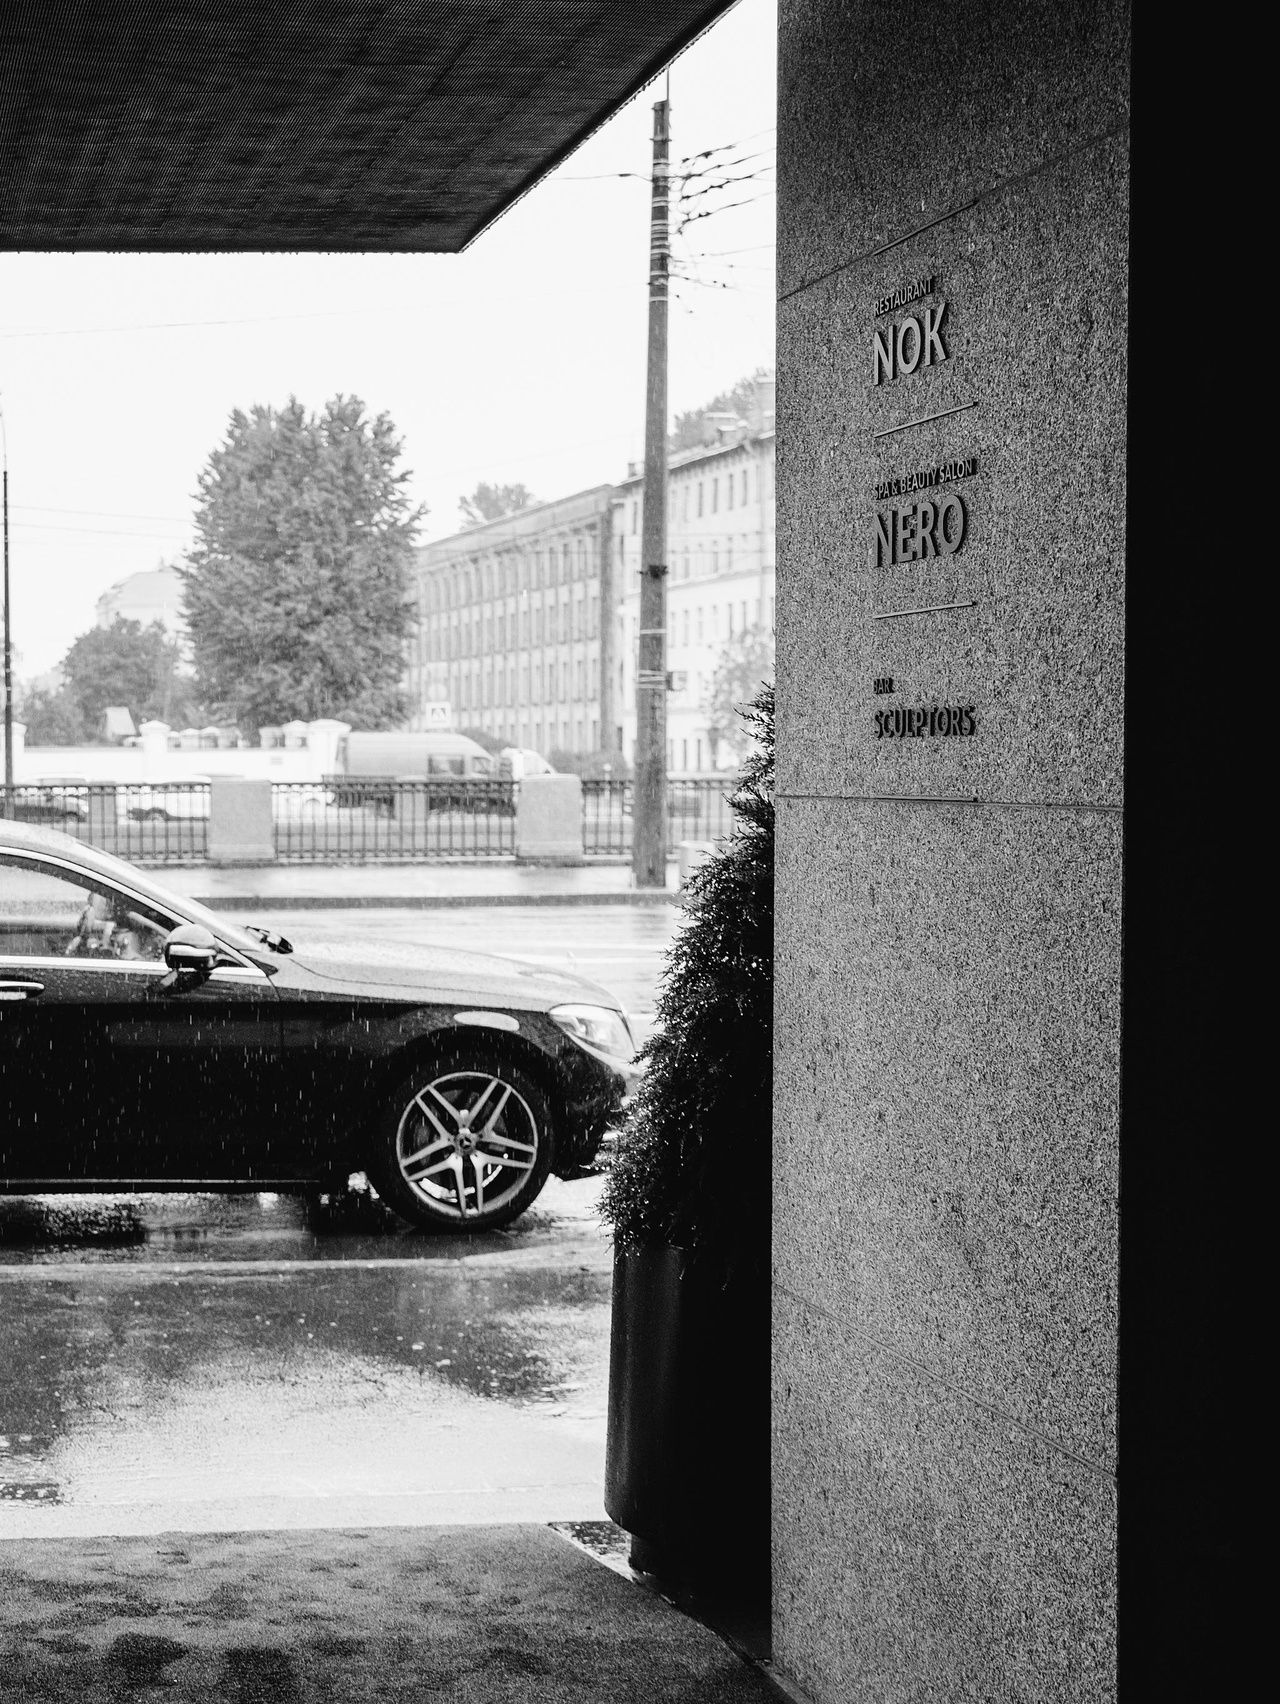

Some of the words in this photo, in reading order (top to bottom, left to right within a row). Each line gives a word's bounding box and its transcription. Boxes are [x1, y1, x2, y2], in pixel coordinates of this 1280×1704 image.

[873, 277, 933, 316] RESTAURANT
[873, 302, 948, 386] NOK
[873, 484, 890, 500] SPA
[891, 480, 898, 496] &
[900, 470, 937, 493] BEAUTY
[939, 459, 973, 483] SALON
[872, 494, 966, 568] NERO
[873, 677, 892, 694] BAR
[873, 705, 974, 738] SCULPTORS
